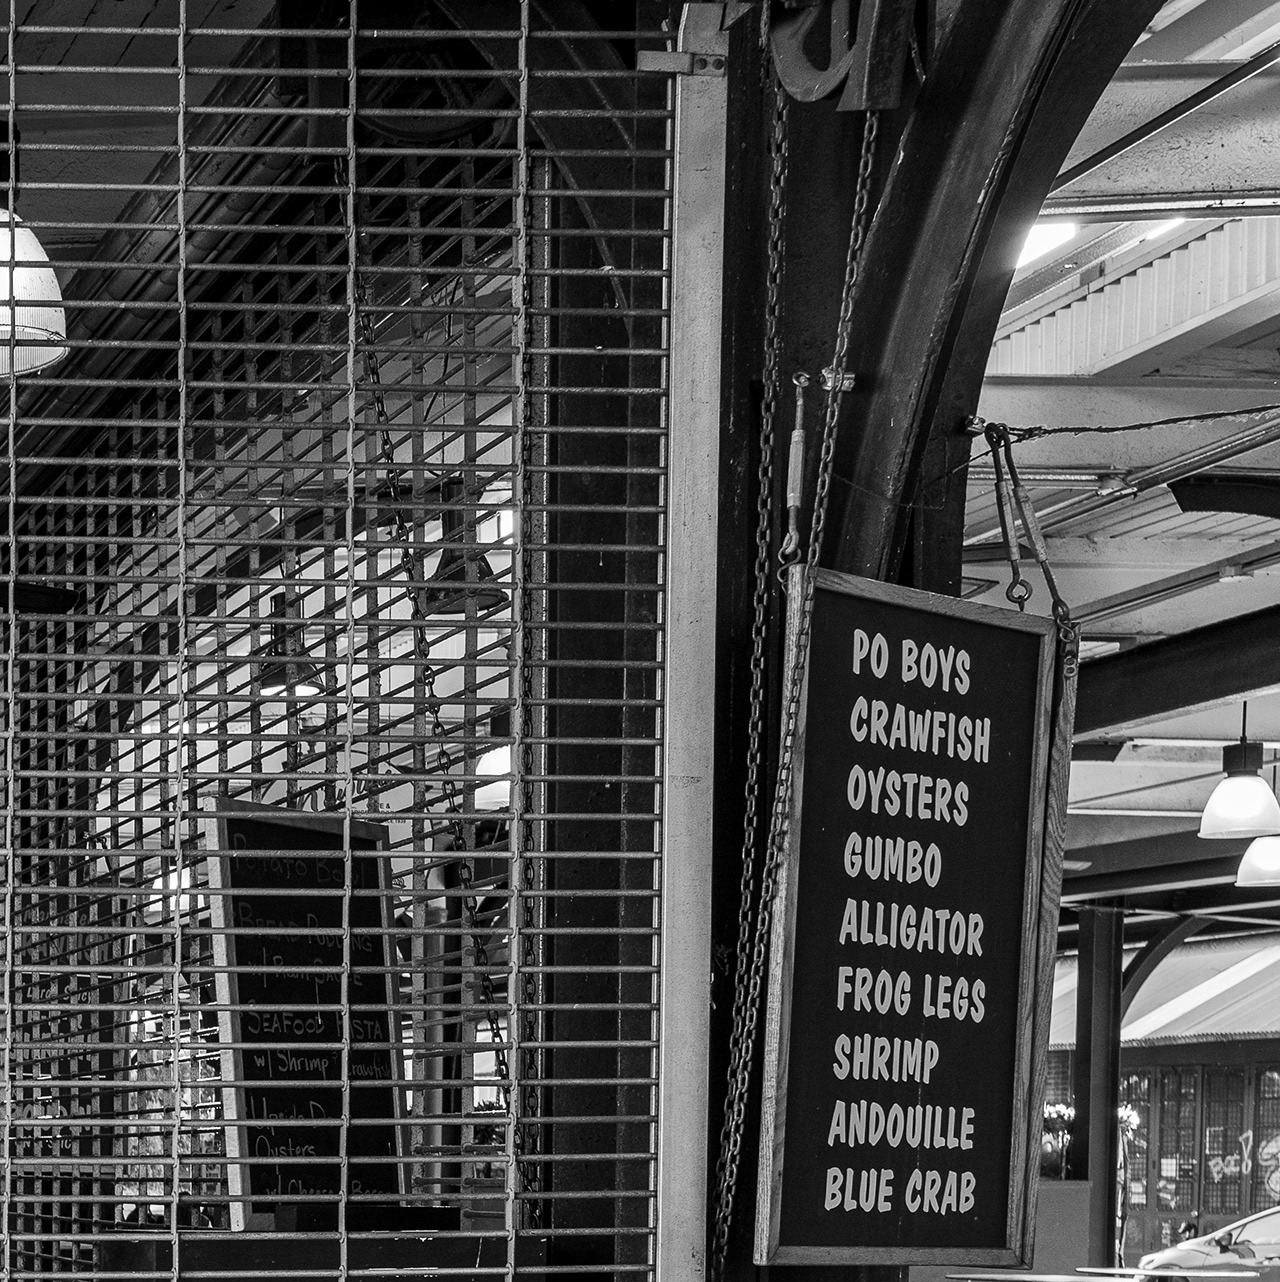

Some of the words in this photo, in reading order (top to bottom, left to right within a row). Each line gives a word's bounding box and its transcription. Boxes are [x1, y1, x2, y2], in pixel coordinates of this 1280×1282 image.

[853, 629, 888, 678] PO
[902, 639, 970, 695] BOYS
[851, 696, 990, 763] CRAWFISH
[848, 765, 968, 826] OYSTERS
[844, 832, 941, 887] GUMBO
[307, 913, 372, 952] PUDDNG
[838, 898, 983, 956] ALLIGATOR
[314, 958, 363, 986] SAUE
[837, 967, 911, 1015] FROG
[923, 974, 985, 1023] LEGS
[247, 1000, 323, 1035] SEAFOOD
[277, 1048, 328, 1081] Shrimp
[346, 1052, 394, 1080] rawfish
[833, 1034, 939, 1084] SHRIMP
[827, 1100, 975, 1150] ANDOUILLE
[255, 1135, 315, 1175] Oysters
[825, 1167, 894, 1212] BLUE
[905, 1169, 976, 1215] CRAB
